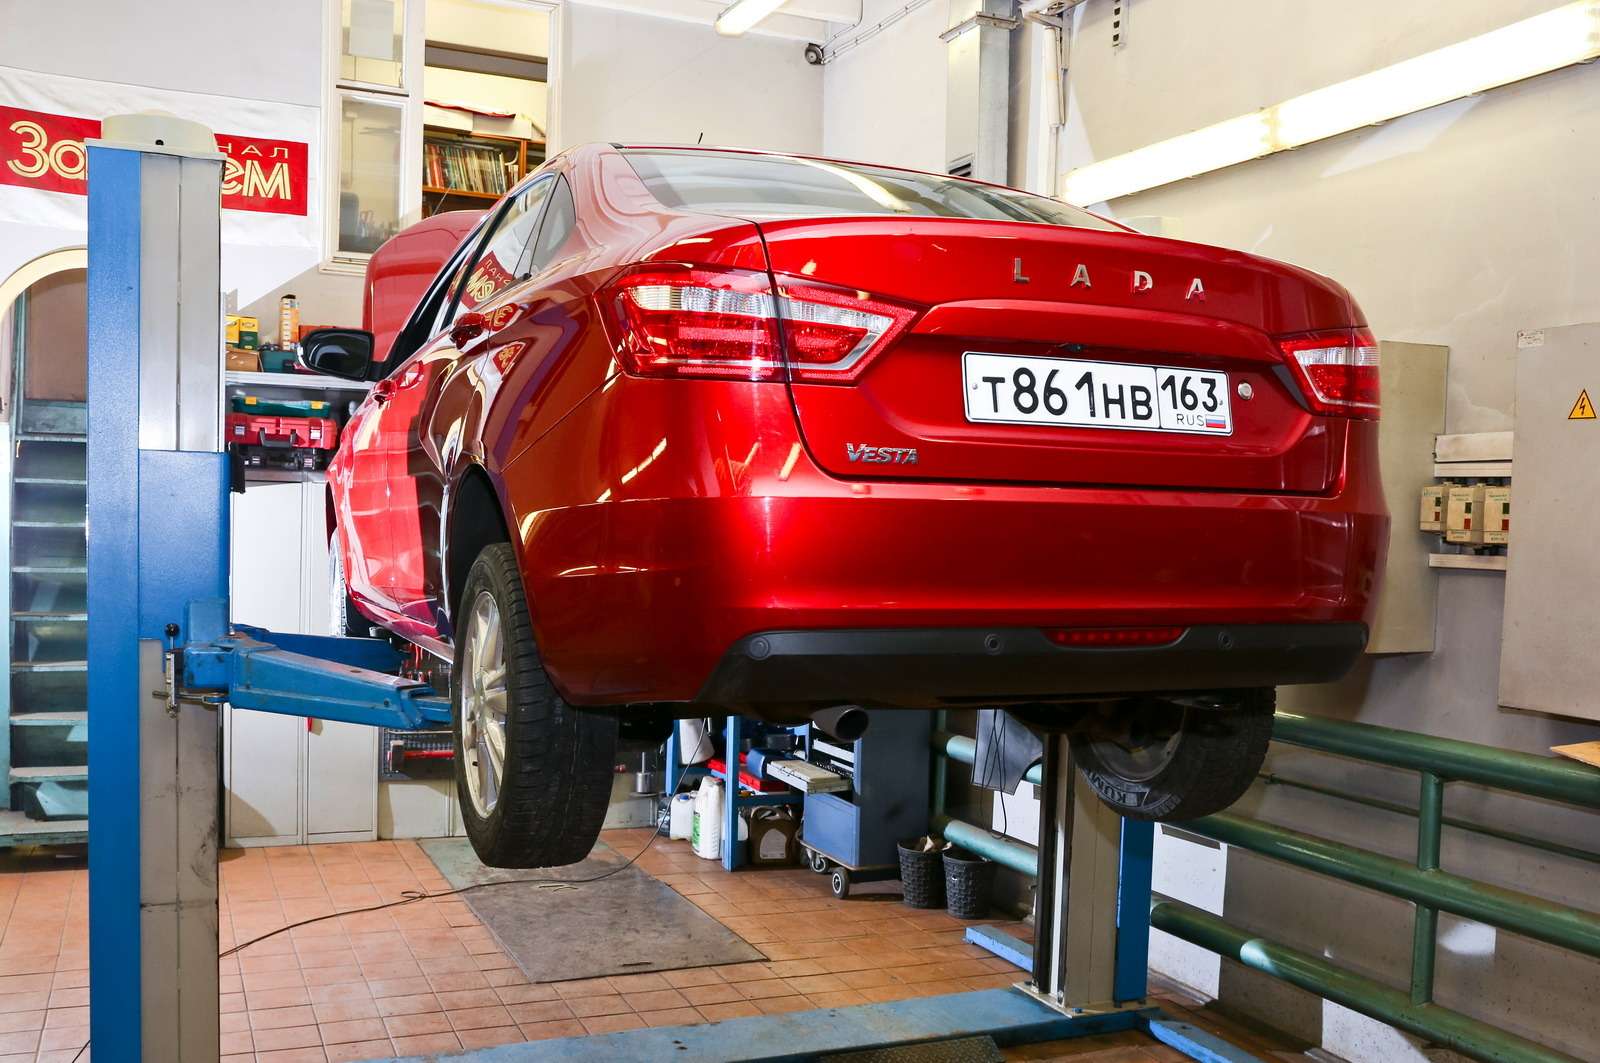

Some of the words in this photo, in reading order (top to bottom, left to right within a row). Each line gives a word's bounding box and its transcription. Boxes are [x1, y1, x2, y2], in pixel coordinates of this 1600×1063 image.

[1013, 257, 1205, 300] LADA
[1161, 375, 1218, 412] 163
[1176, 413, 1205, 426] RUS
[846, 442, 918, 465] VESTA
